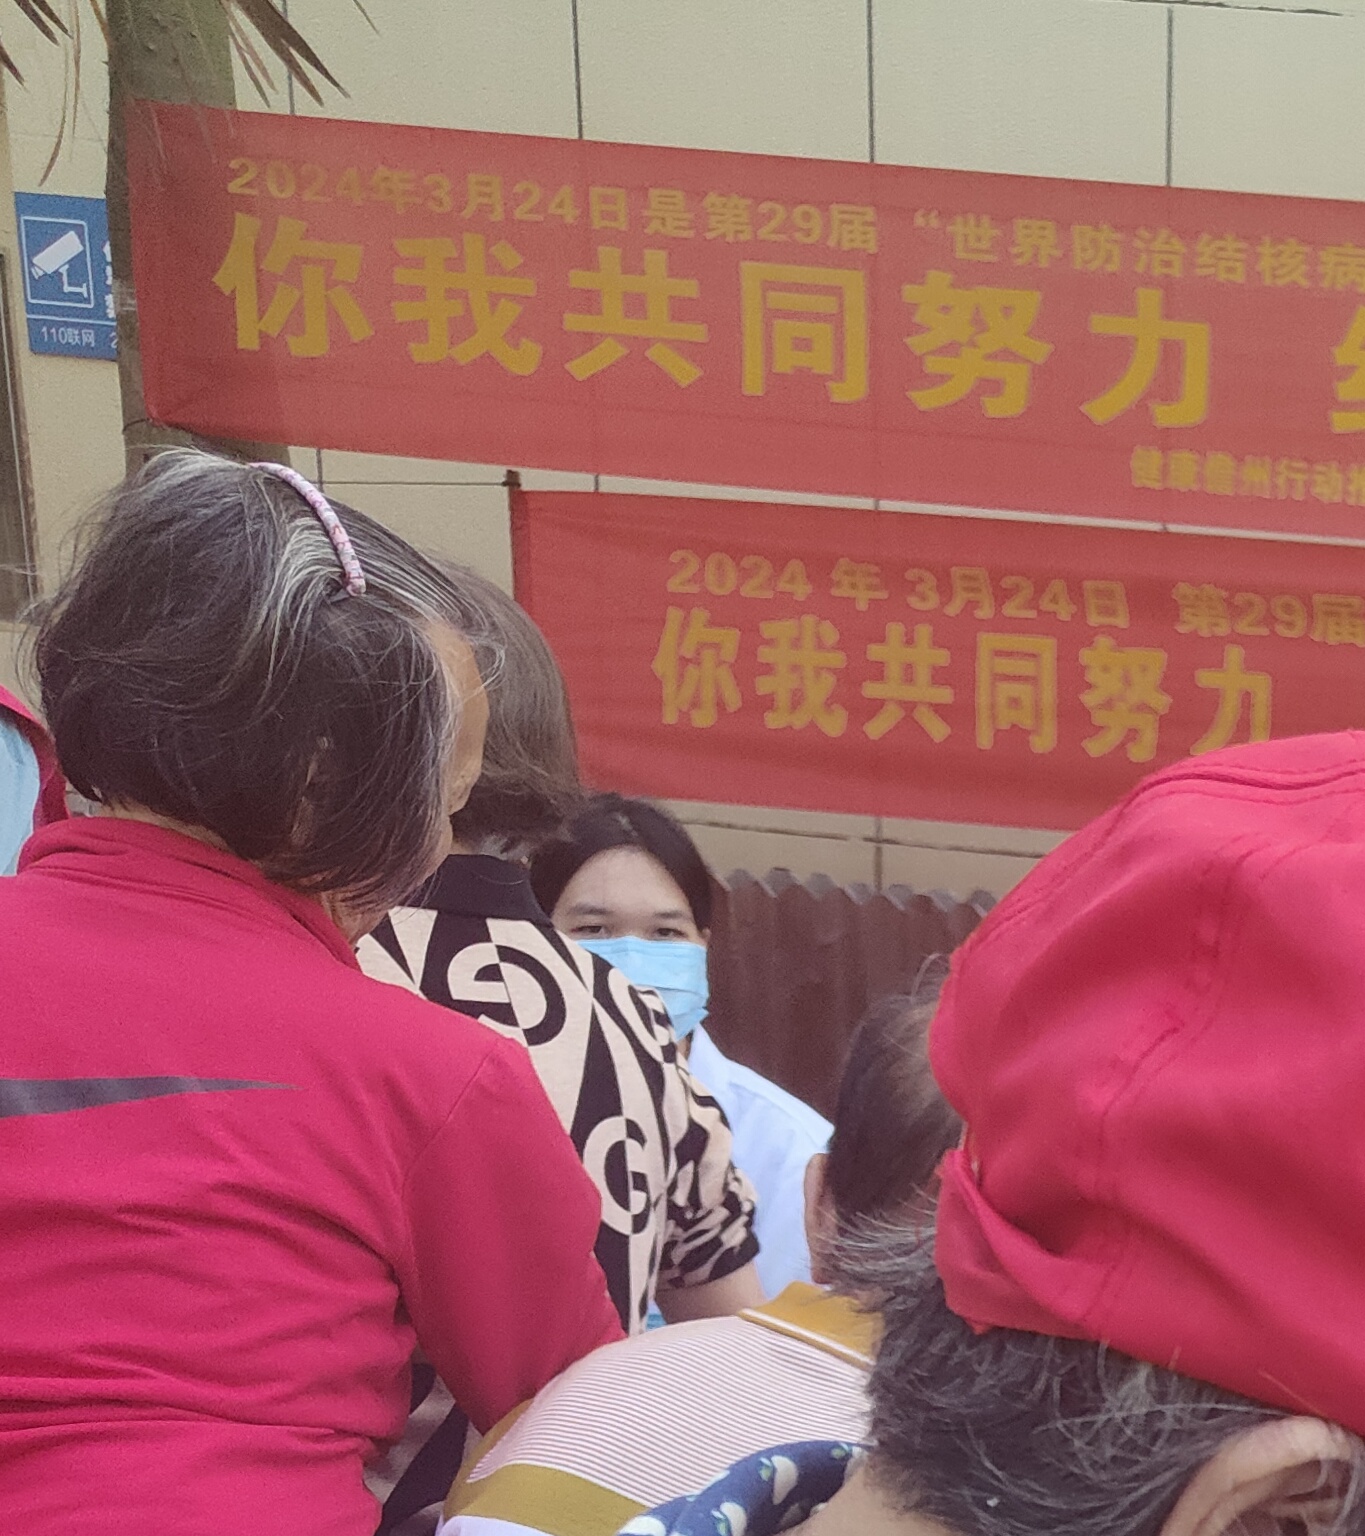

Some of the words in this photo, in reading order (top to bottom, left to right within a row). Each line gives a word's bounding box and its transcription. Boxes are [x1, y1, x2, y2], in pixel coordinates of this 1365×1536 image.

[212, 210, 1212, 428] 你我共同努力
[652, 605, 1271, 762] 你我共同努力
